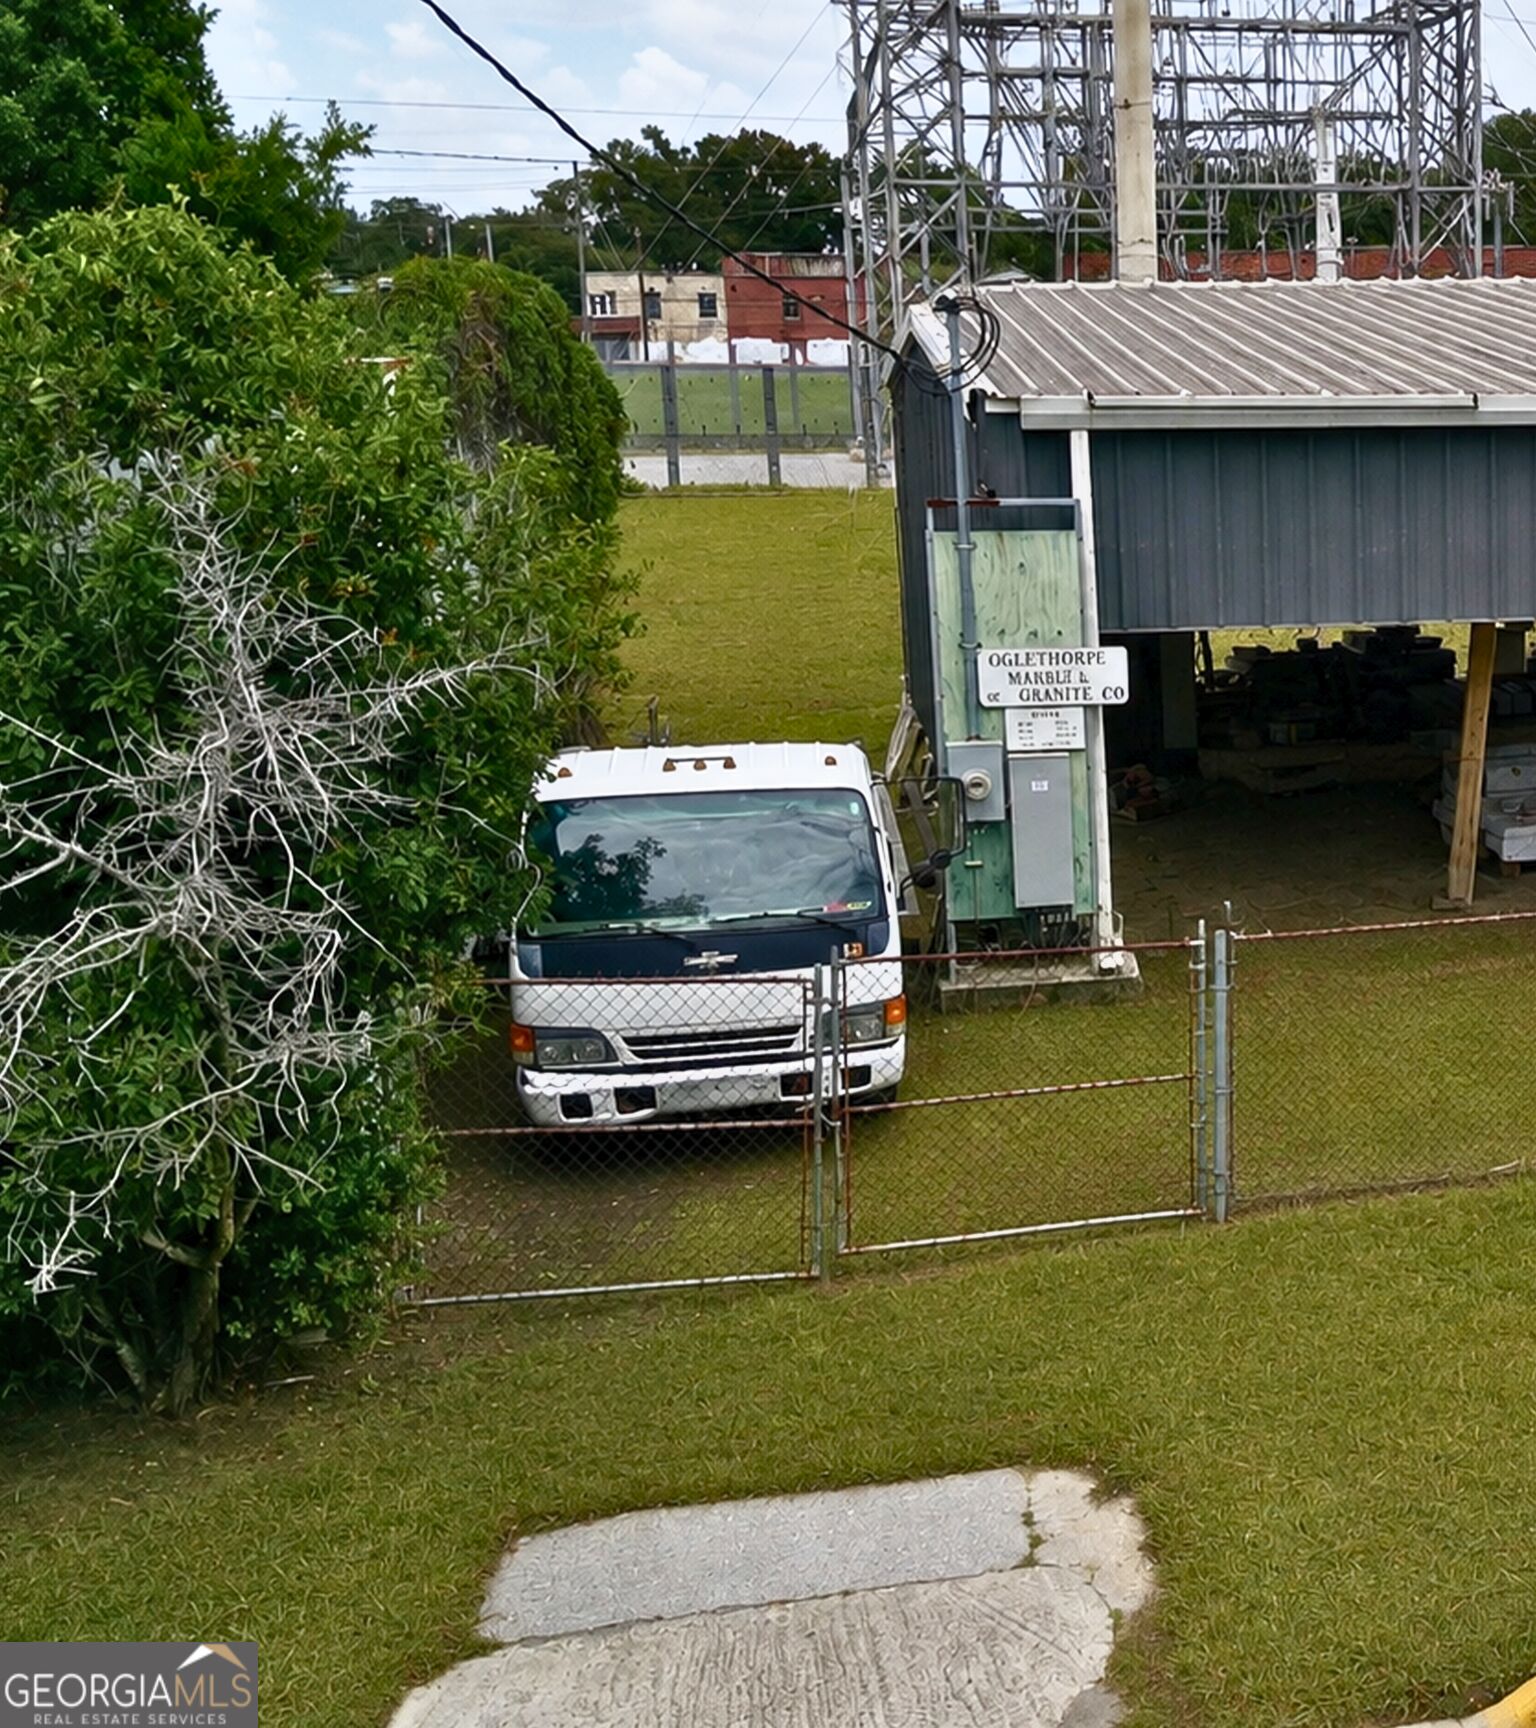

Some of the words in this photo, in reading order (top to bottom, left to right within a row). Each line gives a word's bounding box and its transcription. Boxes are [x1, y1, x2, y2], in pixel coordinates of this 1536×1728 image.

[988, 651, 1106, 667] OGLETHORPE
[1019, 686, 1093, 702] GRANITE
[1102, 686, 1124, 700] CO
